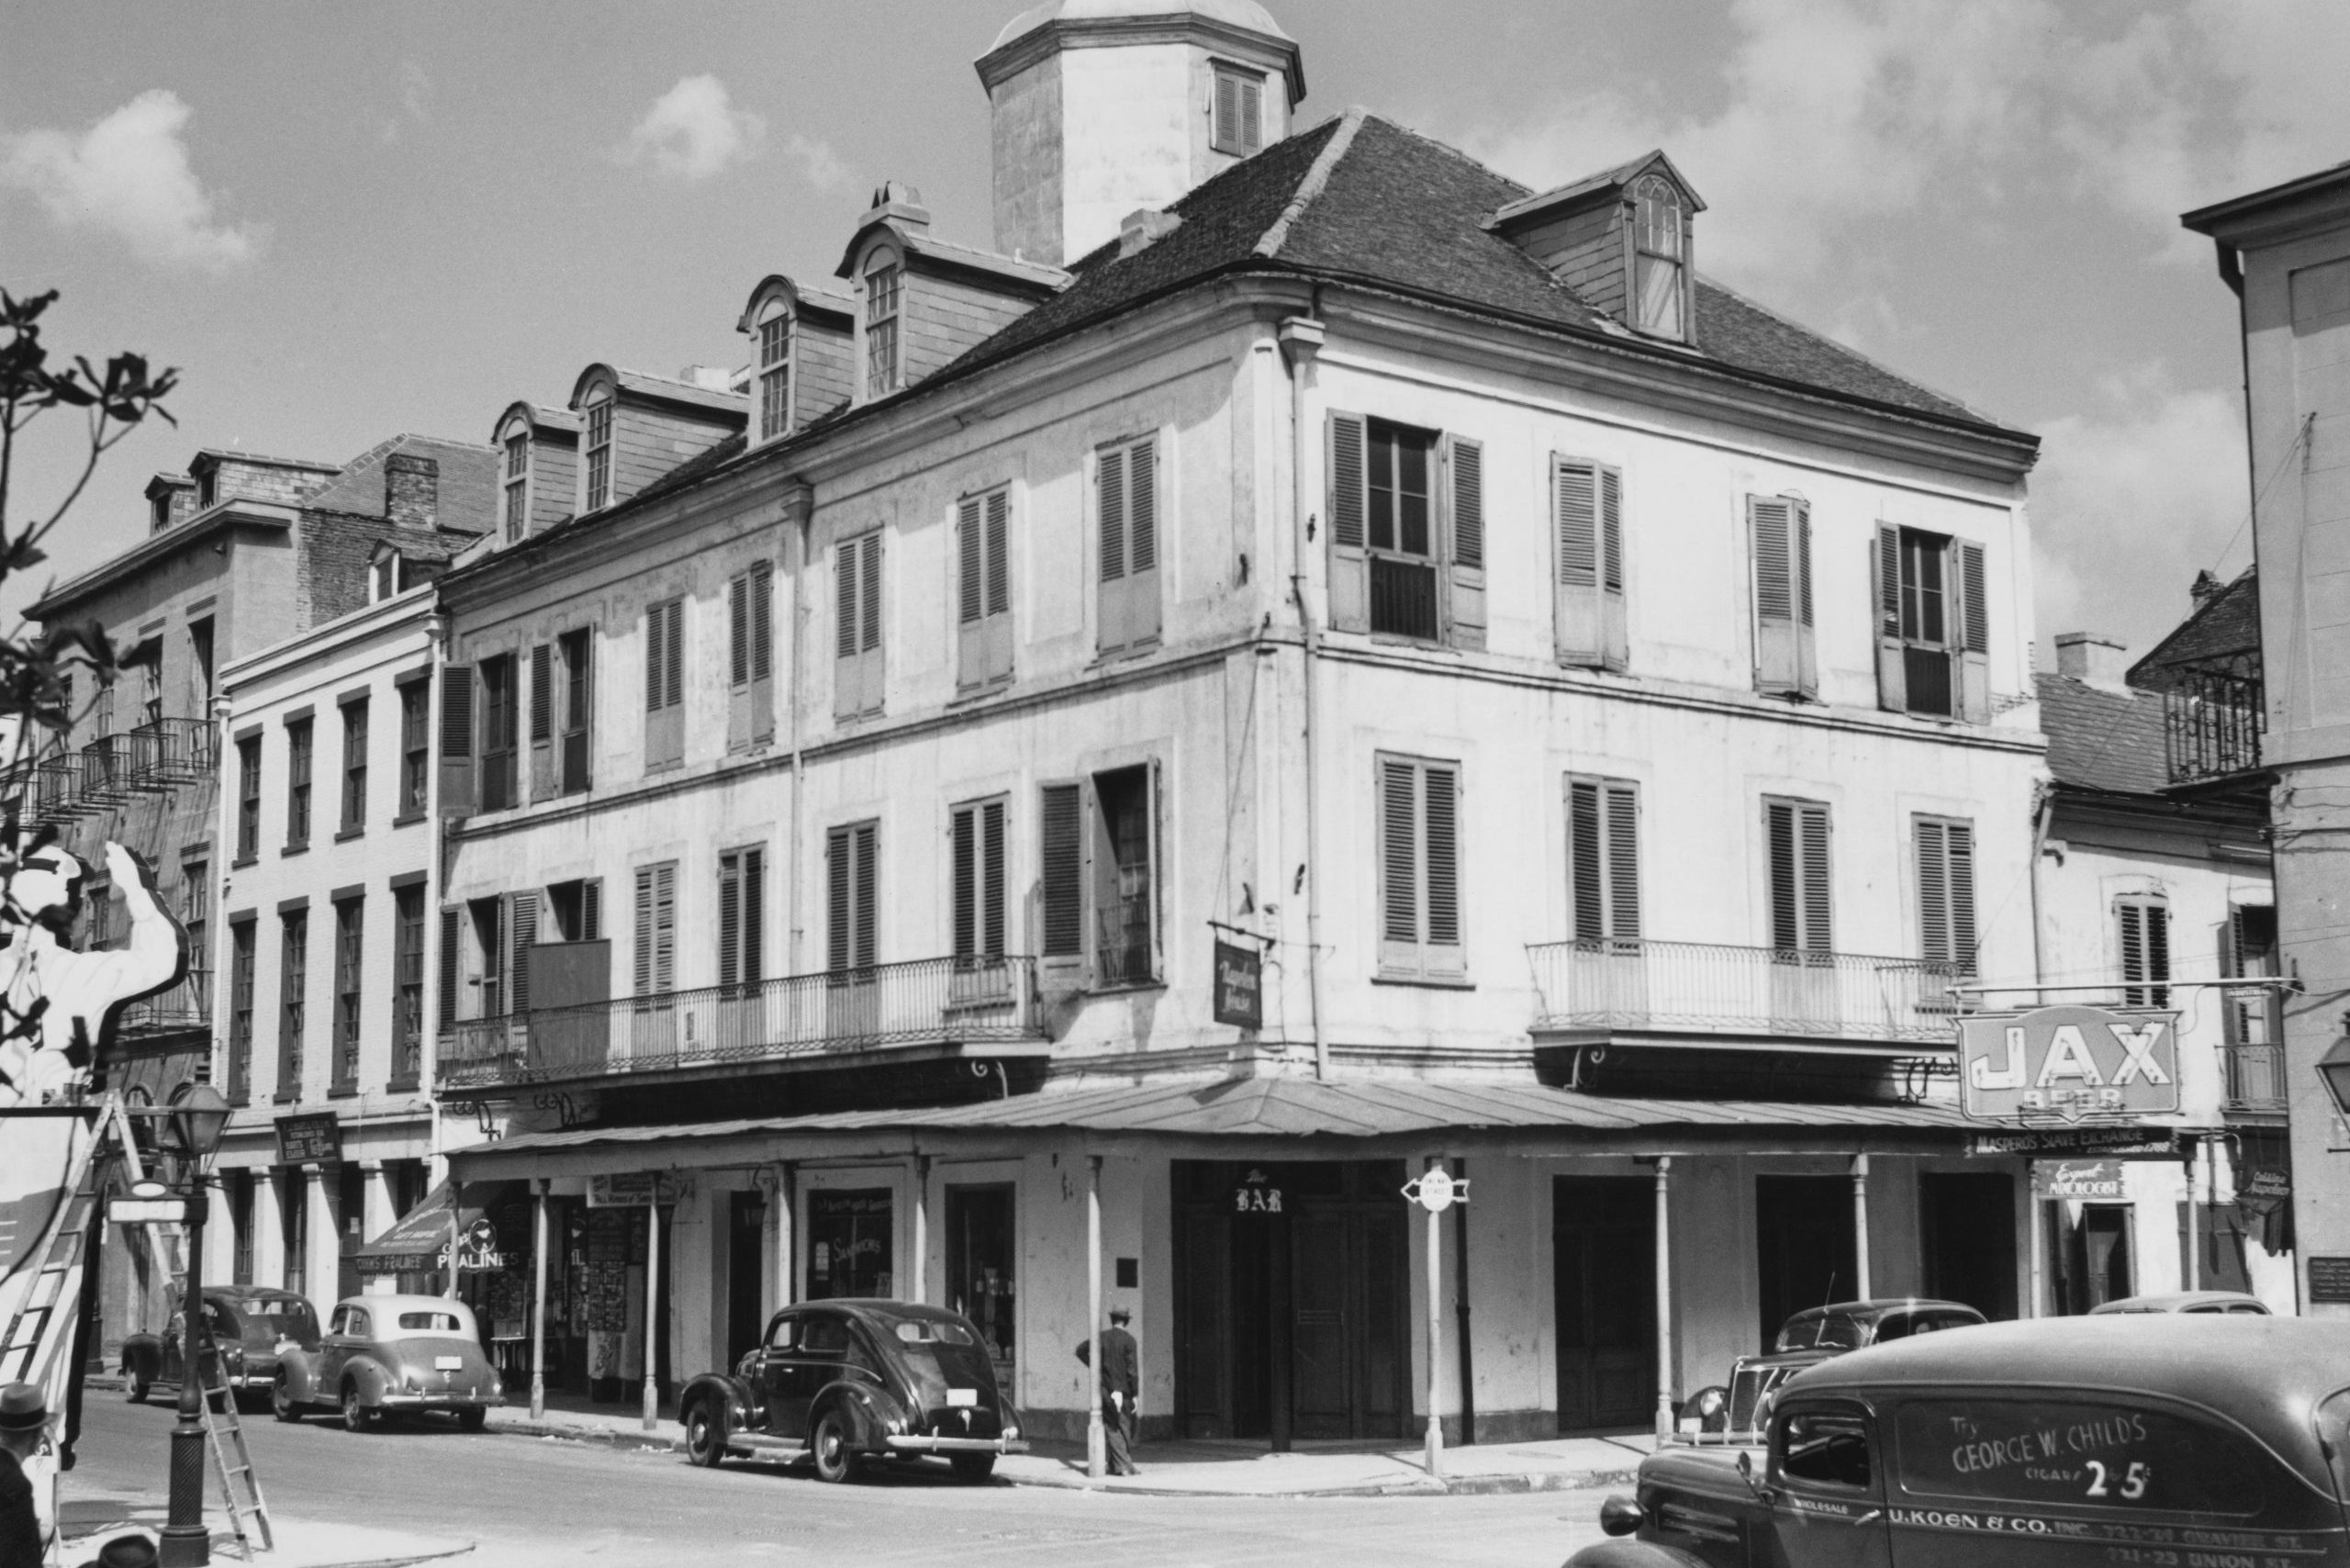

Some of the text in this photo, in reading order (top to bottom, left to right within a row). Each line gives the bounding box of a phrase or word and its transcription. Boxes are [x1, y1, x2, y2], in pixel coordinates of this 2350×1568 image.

[1970, 1023, 2172, 1090] JAX
[2023, 1089, 2121, 1109] BEER
[2079, 1128, 2144, 1146] EXCHANGE
[1235, 1188, 1281, 1213] BAR
[436, 1252, 519, 1269] PALINES
[1953, 1434, 2035, 1473] GEORGE
[2066, 1413, 2147, 1451] CHILDS
[2085, 1460, 2108, 1496] 2
[1986, 1516, 2004, 1530] &
[2010, 1518, 2053, 1533] CO.
